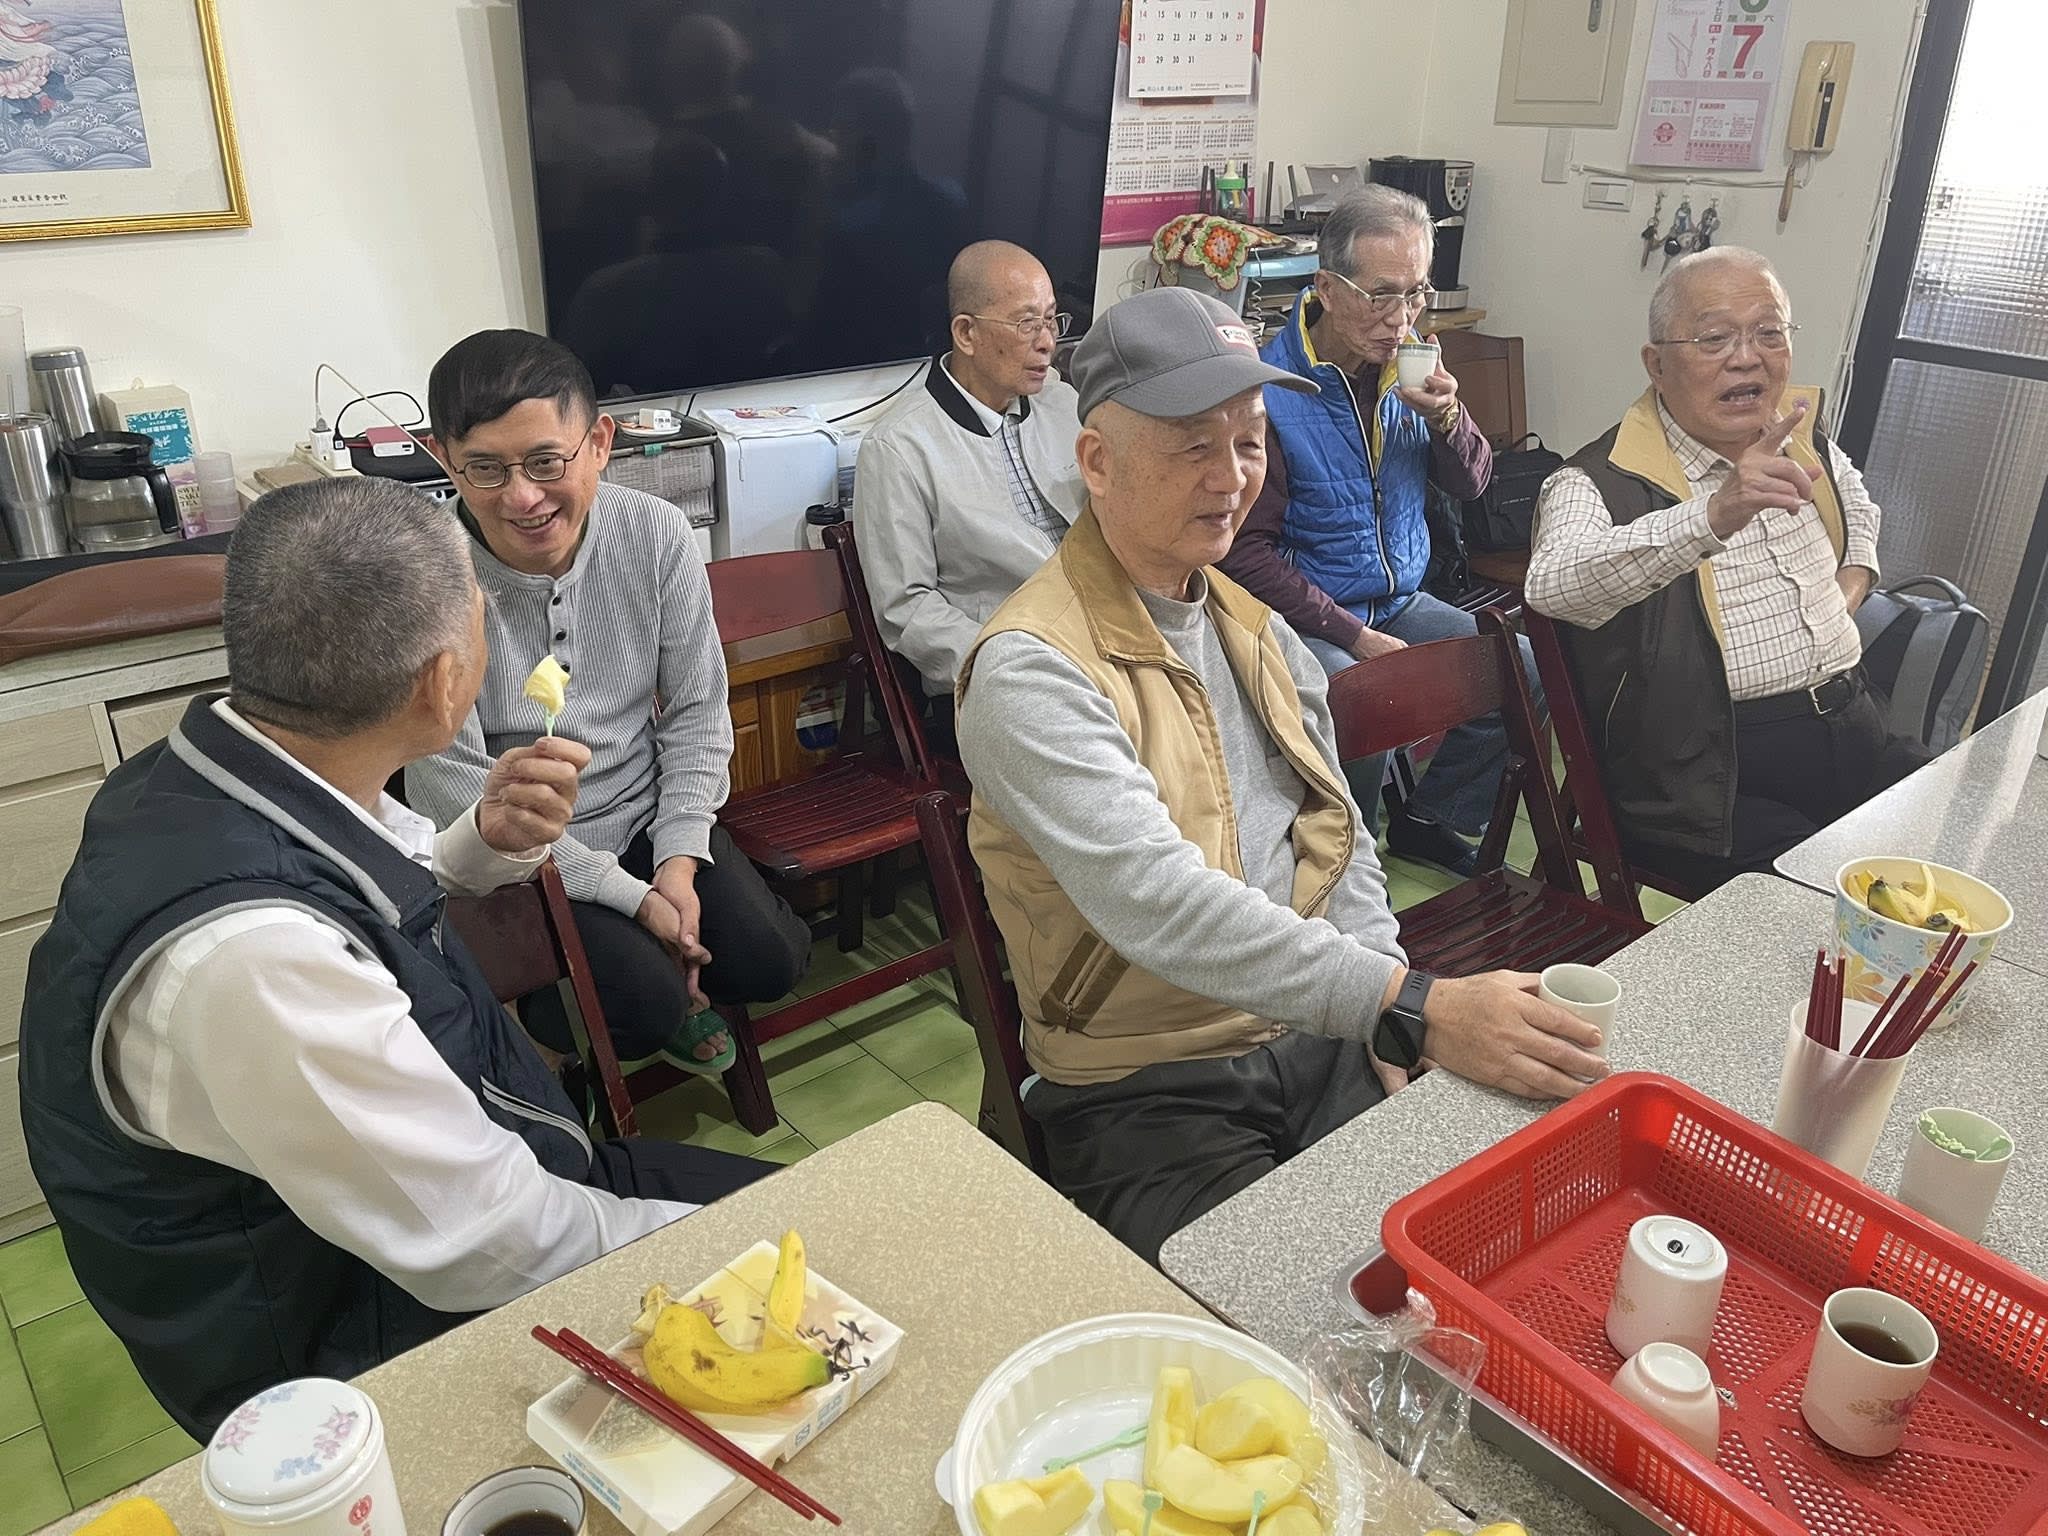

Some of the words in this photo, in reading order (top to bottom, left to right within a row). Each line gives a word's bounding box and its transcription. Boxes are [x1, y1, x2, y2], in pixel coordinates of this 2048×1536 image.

[1158, 10, 1165, 18] 15
[1174, 11, 1181, 19] 16
[1190, 11, 1197, 19] 17
[1206, 11, 1213, 19] 18
[1222, 11, 1229, 19] 19
[1237, 12, 1244, 20] 20
[1138, 33, 1146, 41] 21
[1157, 33, 1164, 41] 22
[1173, 33, 1180, 41] 23
[1189, 33, 1196, 41] 24
[1205, 34, 1212, 42] 25
[1733, 25, 1764, 69] 7
[1137, 56, 1146, 64] 28
[1156, 56, 1163, 64] 29
[1173, 56, 1180, 64] 30
[1188, 56, 1195, 64] 31
